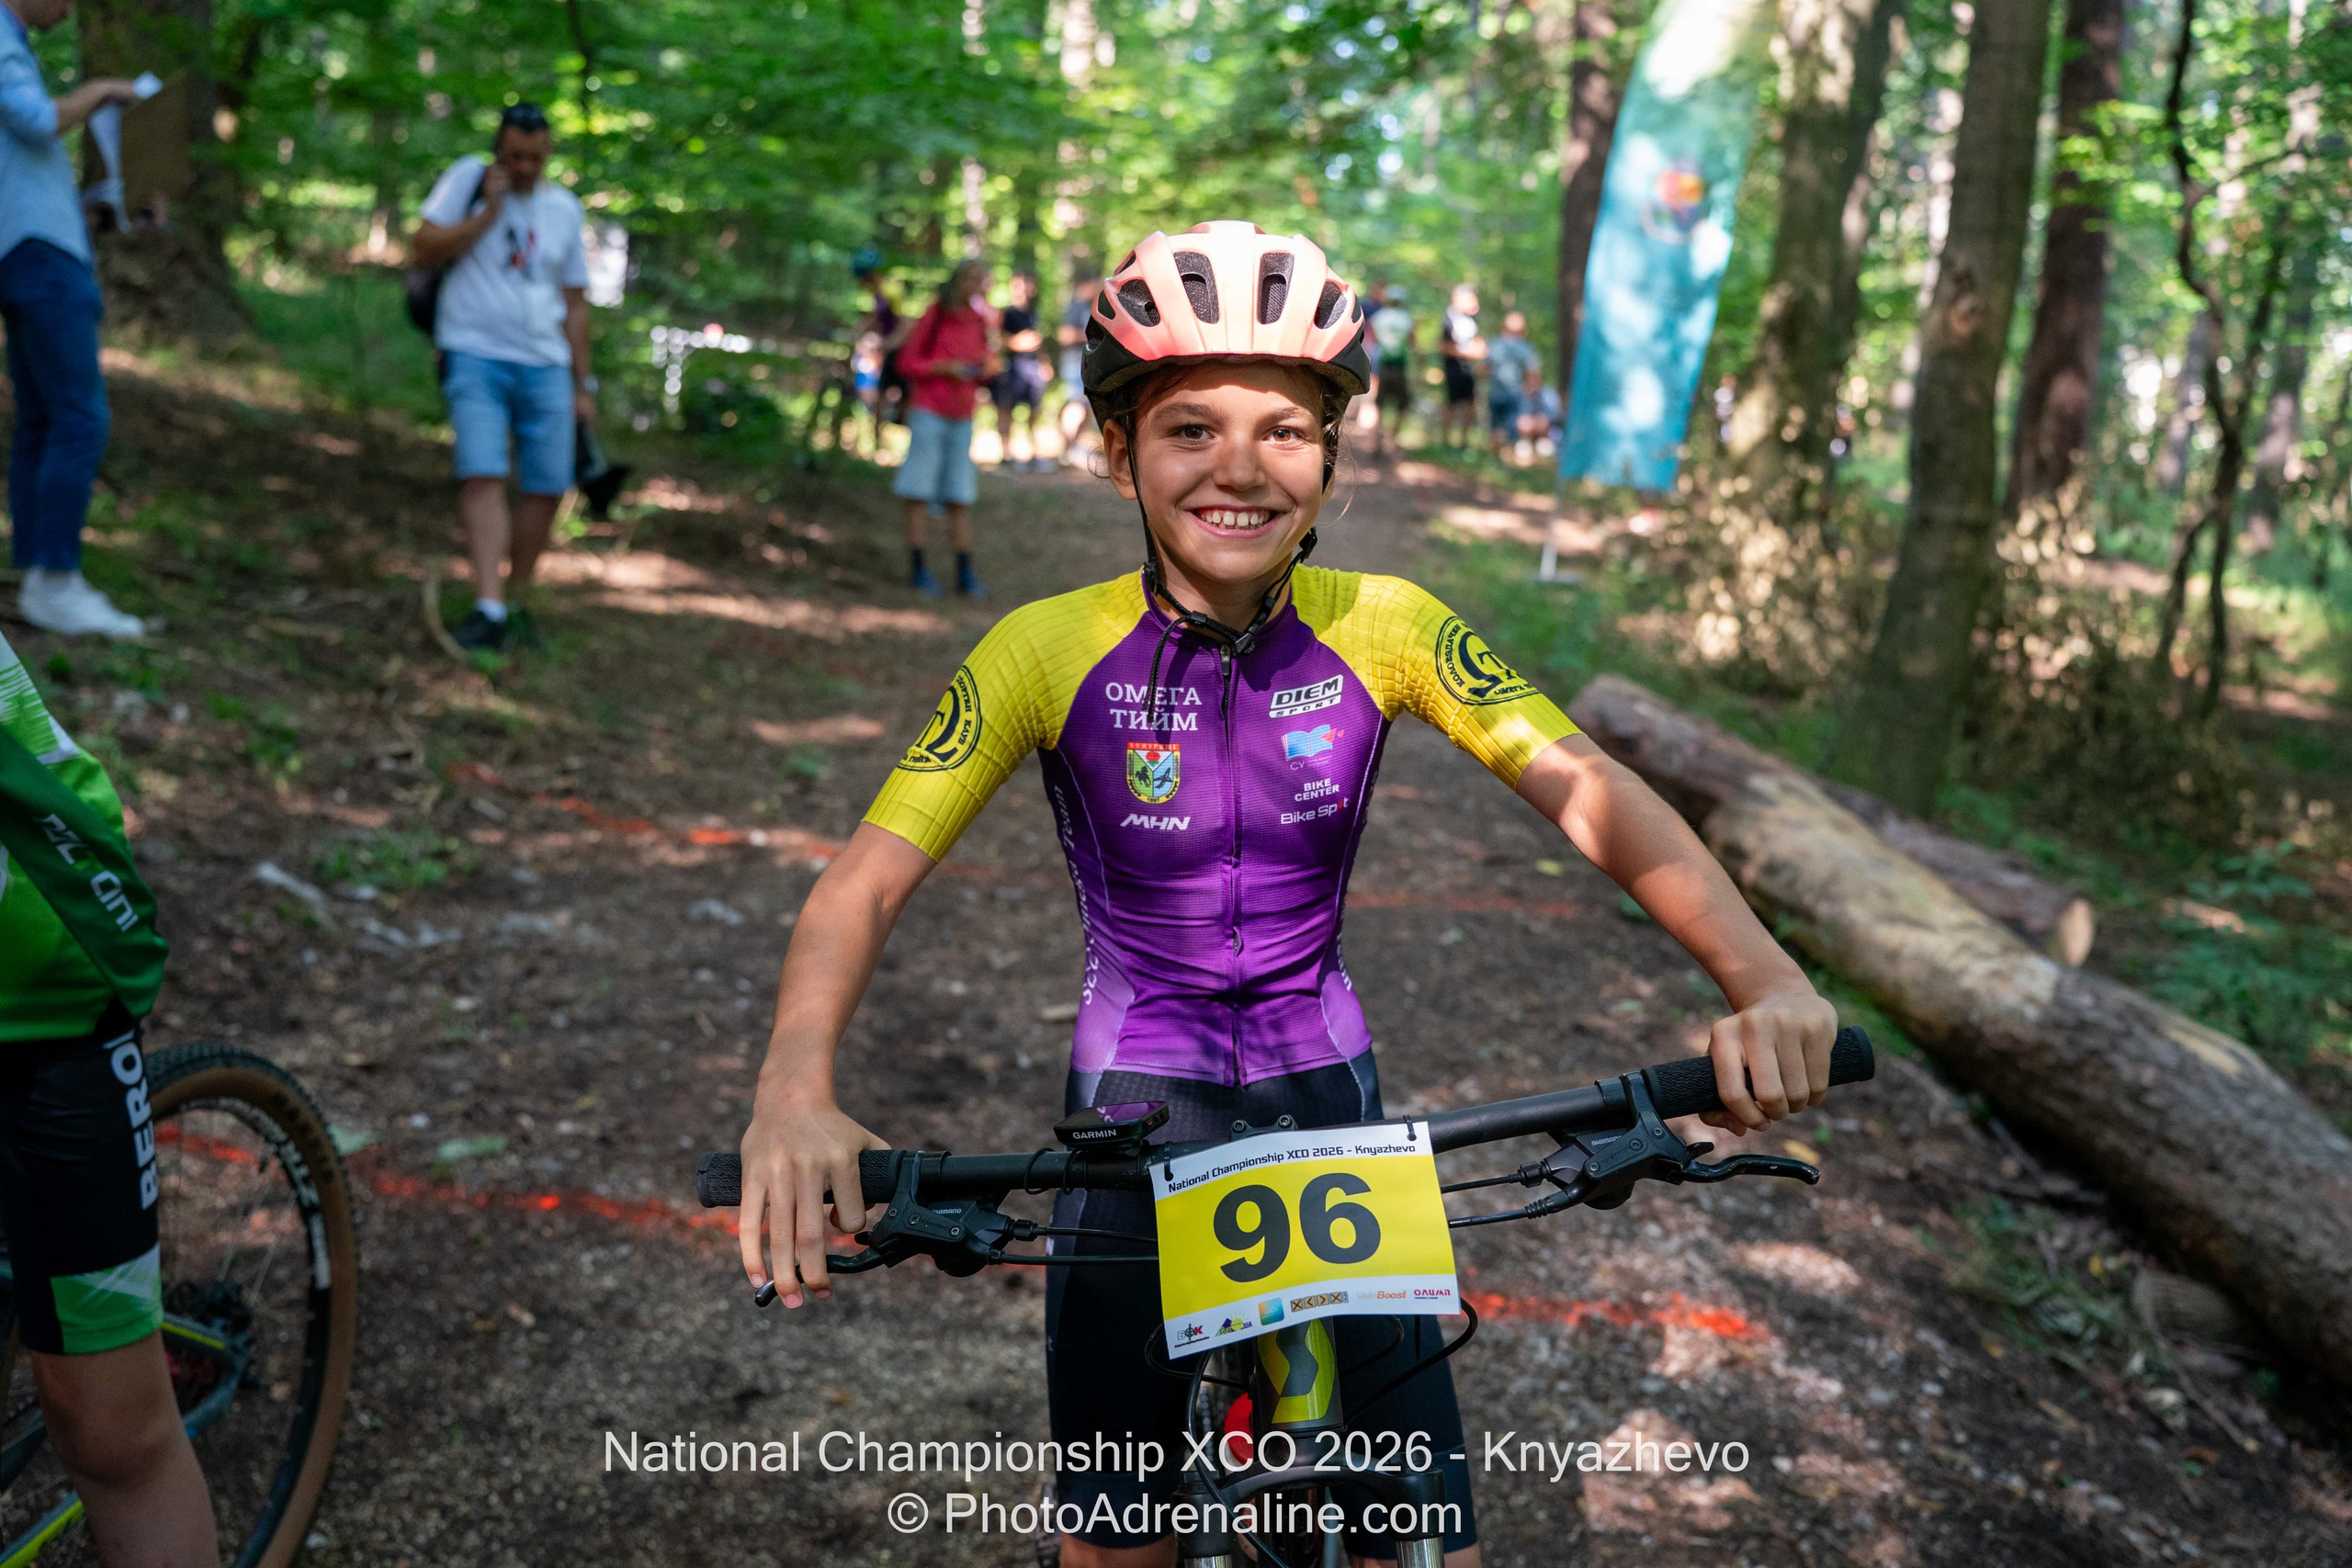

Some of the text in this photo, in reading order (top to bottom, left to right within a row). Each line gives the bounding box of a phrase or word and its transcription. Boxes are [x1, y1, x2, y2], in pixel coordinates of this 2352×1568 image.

[1105, 682, 1203, 705] ОМЕГА
[1275, 678, 1339, 706] DIEM
[1275, 697, 1336, 717] SPORT
[1110, 707, 1198, 731] ТИЙМ
[1294, 784, 1340, 802] CENTER
[1304, 778, 1331, 792] BIKE
[1281, 809, 1316, 825] Bike
[1072, 1128, 1117, 1140] GARMIN
[1590, 1135, 1622, 1146] SHIMAN
[1169, 1171, 1209, 1192] National
[1212, 1152, 1284, 1178] Championship
[1286, 1148, 1309, 1159] XCO
[1313, 1145, 1343, 1156] 2026
[1355, 1145, 1416, 1156] Knyazhevo
[1213, 1172, 1382, 1283] 96
